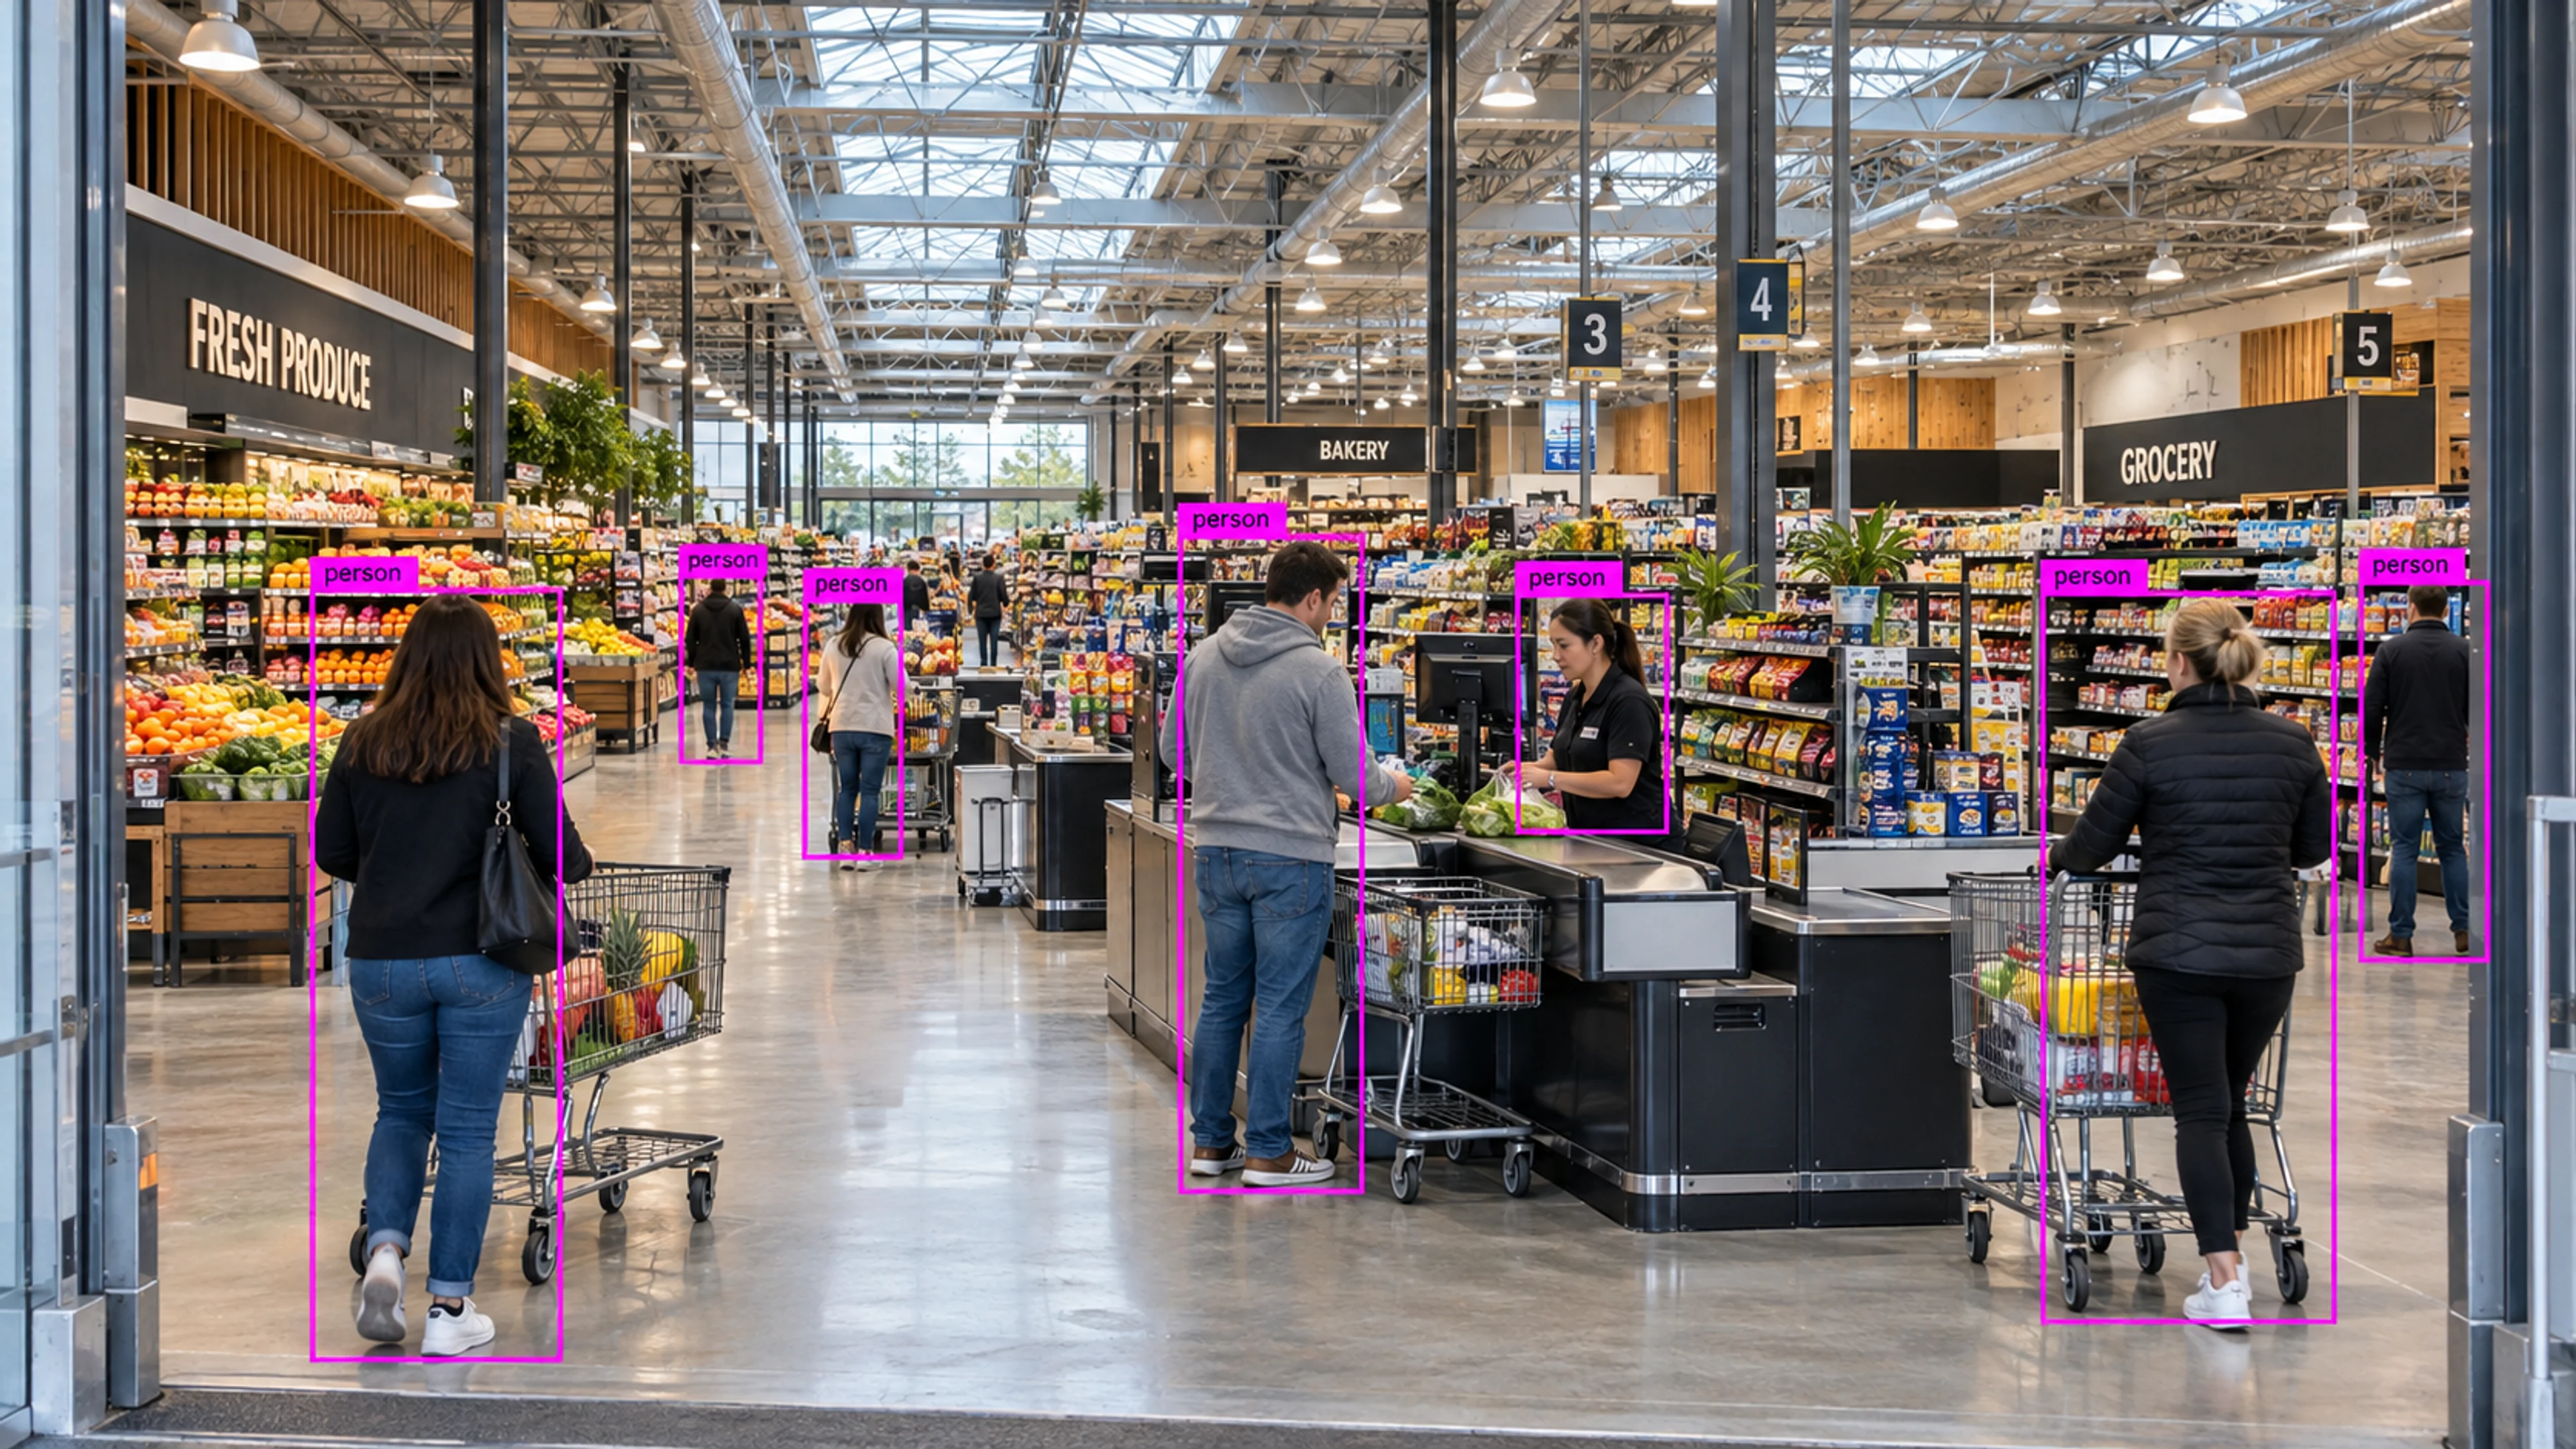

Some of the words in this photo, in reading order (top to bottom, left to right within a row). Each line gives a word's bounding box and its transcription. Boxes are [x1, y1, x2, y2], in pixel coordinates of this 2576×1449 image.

[1750, 276, 1773, 322] 4
[191, 297, 274, 387] FRESH
[280, 326, 372, 411] PRODUCE
[1582, 313, 1608, 356] 3
[2356, 325, 2379, 367] 5
[1319, 439, 1390, 461] BAKERY
[2120, 439, 2218, 486] GROCERY
